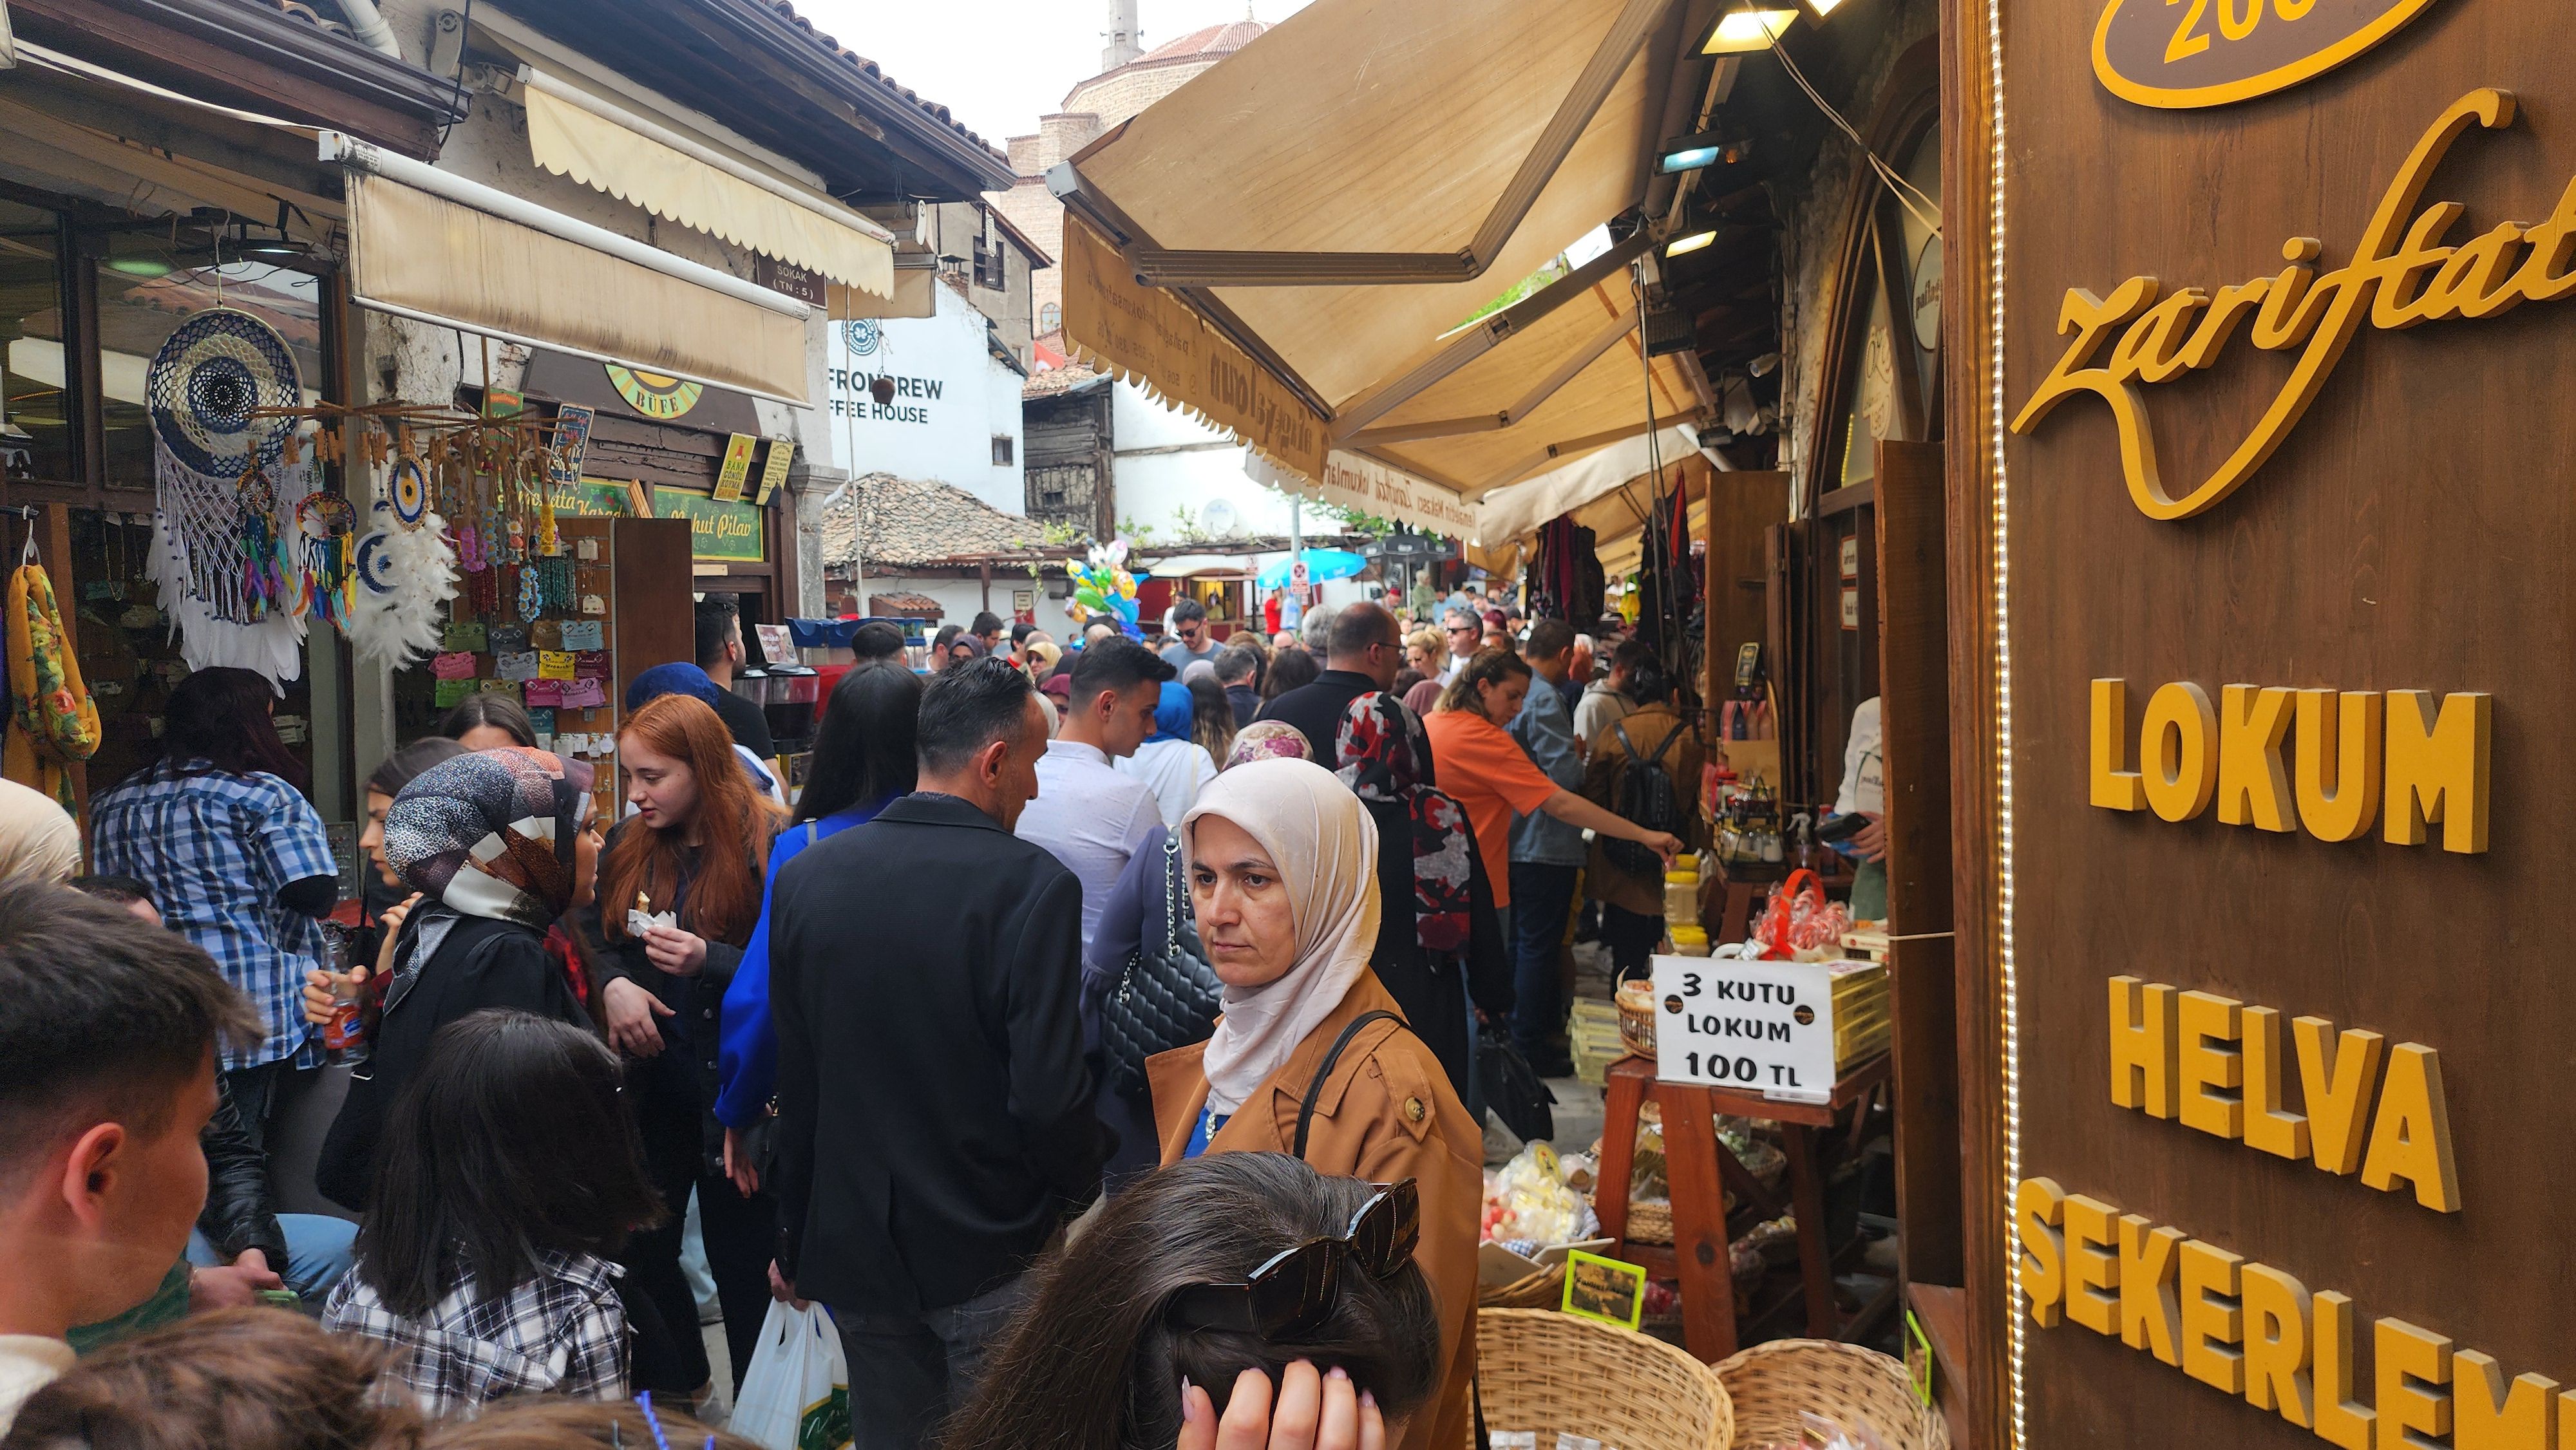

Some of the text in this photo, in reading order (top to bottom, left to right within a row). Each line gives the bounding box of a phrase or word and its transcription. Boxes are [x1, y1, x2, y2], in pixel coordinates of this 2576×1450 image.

[777, 265, 808, 283] SOKAK
[636, 390, 678, 413] BÜFE
[872, 404, 928, 424] HOUSE
[726, 460, 745, 471] BANA
[671, 509, 751, 539] hut Pilav
[2090, 677, 2491, 854] LOKUM
[1683, 973, 1795, 1005] 3 KUTU
[1687, 1014, 1791, 1043] LOKUM
[1686, 1052, 1803, 1087] 100 TL
[2108, 975, 2461, 1214] HELVA
[2016, 1176, 2576, 1450] ŞEKERLEM
